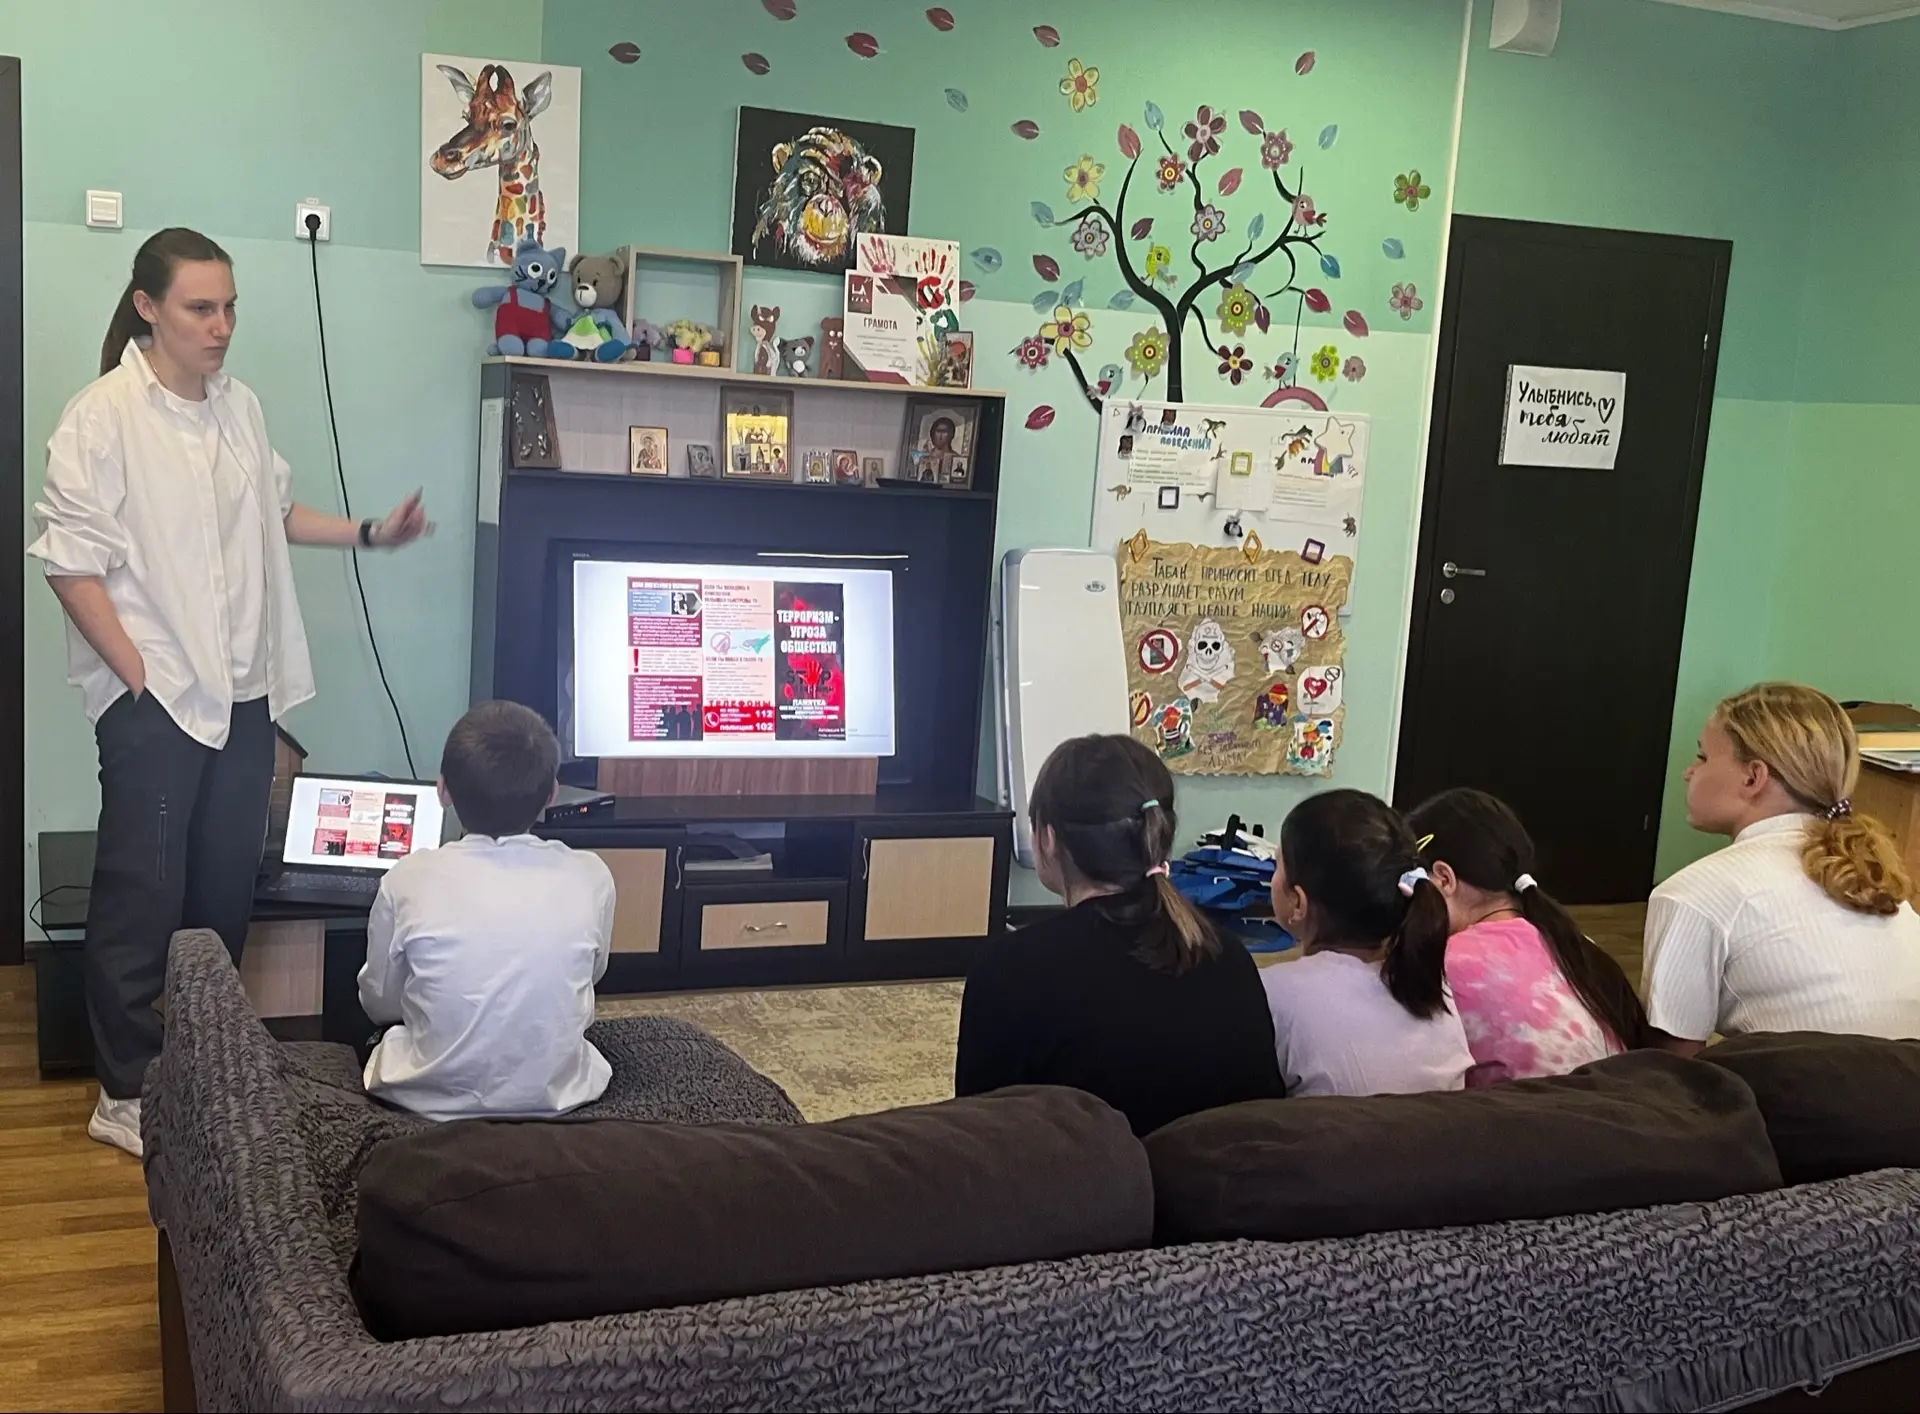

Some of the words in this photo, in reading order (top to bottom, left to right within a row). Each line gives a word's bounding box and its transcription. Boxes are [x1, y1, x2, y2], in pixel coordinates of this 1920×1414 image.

[863, 317, 898, 330] ГРАМОТА
[1541, 418, 1610, 446] любят
[1131, 581, 1200, 598] РАЗРУШАЕТ
[777, 609, 834, 625] ТЕРРОРИЗМ
[790, 625, 827, 639] УГРОЗА
[780, 640, 838, 655] ОБЩЕСТВУ!
[755, 709, 773, 718] 112
[755, 722, 774, 731] 102
